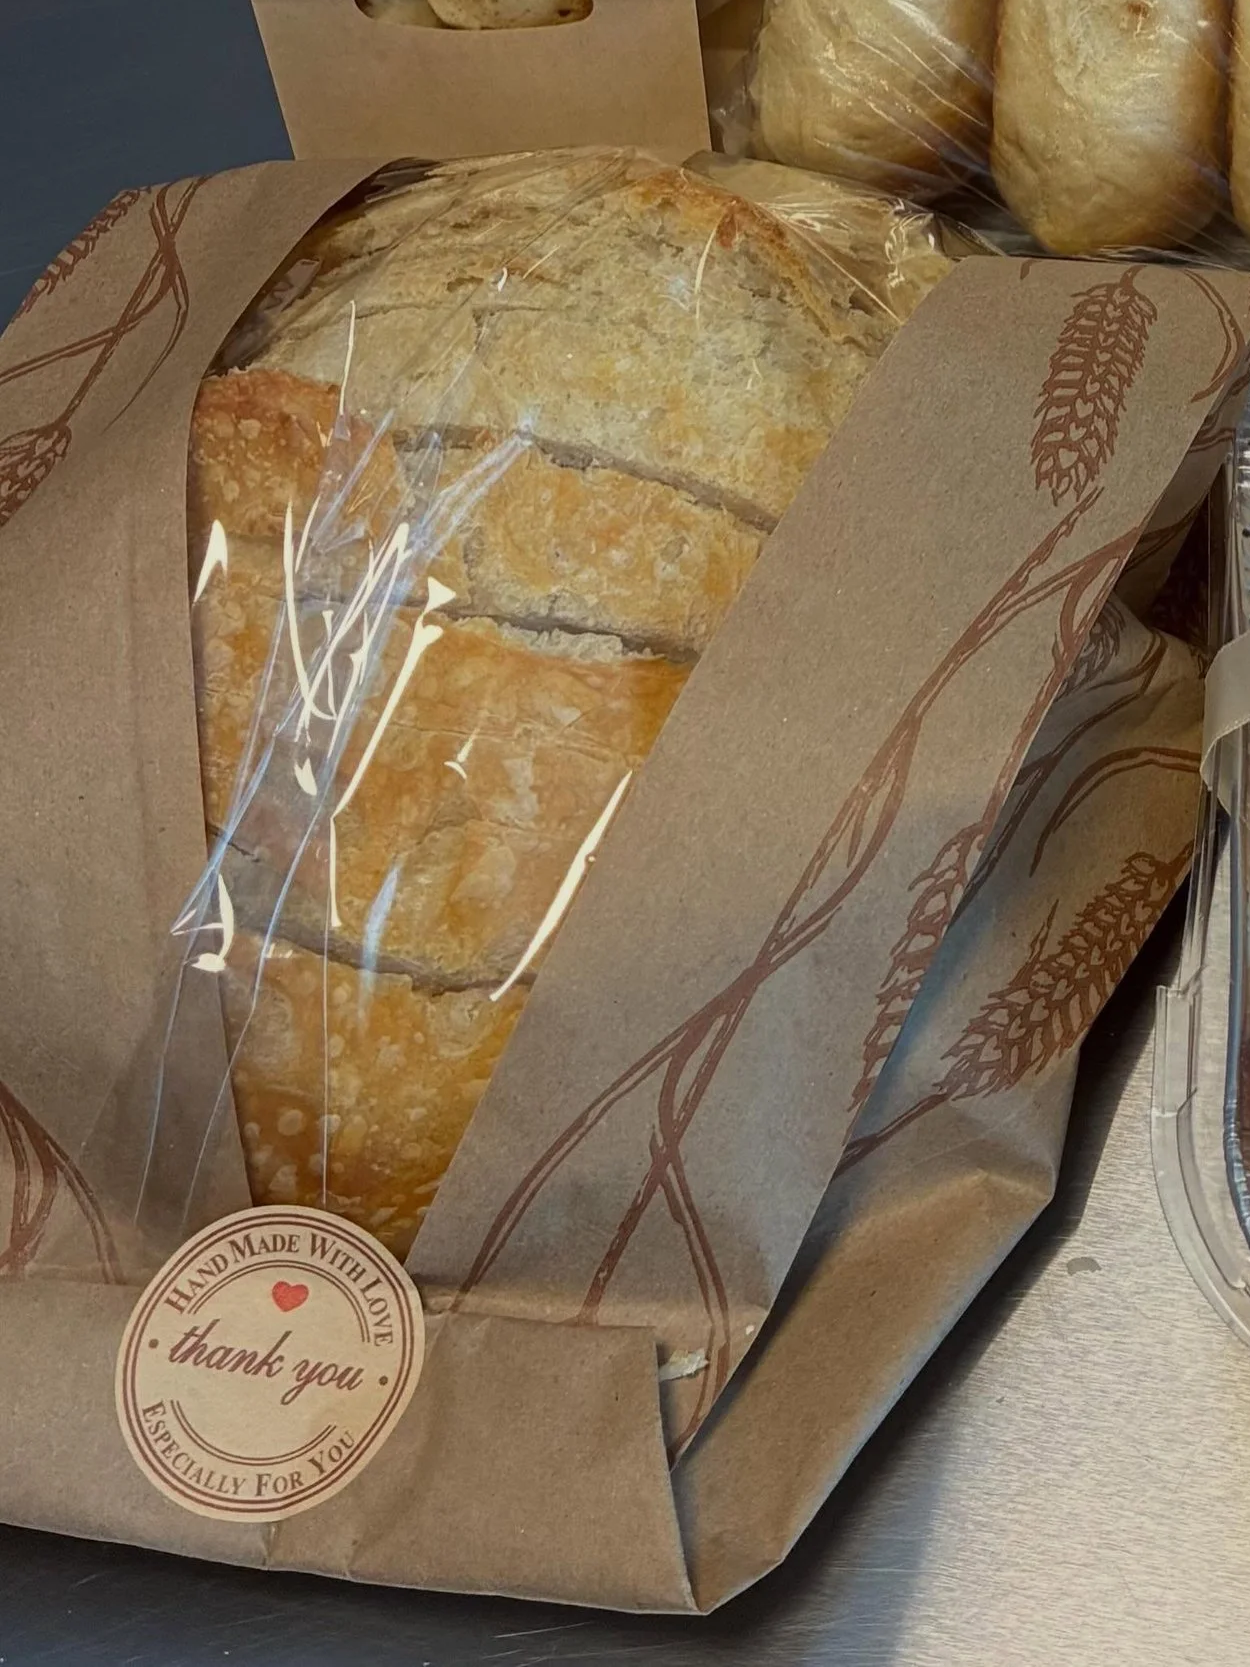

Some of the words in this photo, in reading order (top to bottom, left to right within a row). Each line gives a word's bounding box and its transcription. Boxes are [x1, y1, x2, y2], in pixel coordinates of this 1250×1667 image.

[168, 1318, 292, 1378] thank
[280, 1358, 365, 1406] you
[141, 1400, 247, 1497] ESPECIALLY
[255, 1472, 305, 1497] FOR
[307, 1430, 357, 1477] YOU
